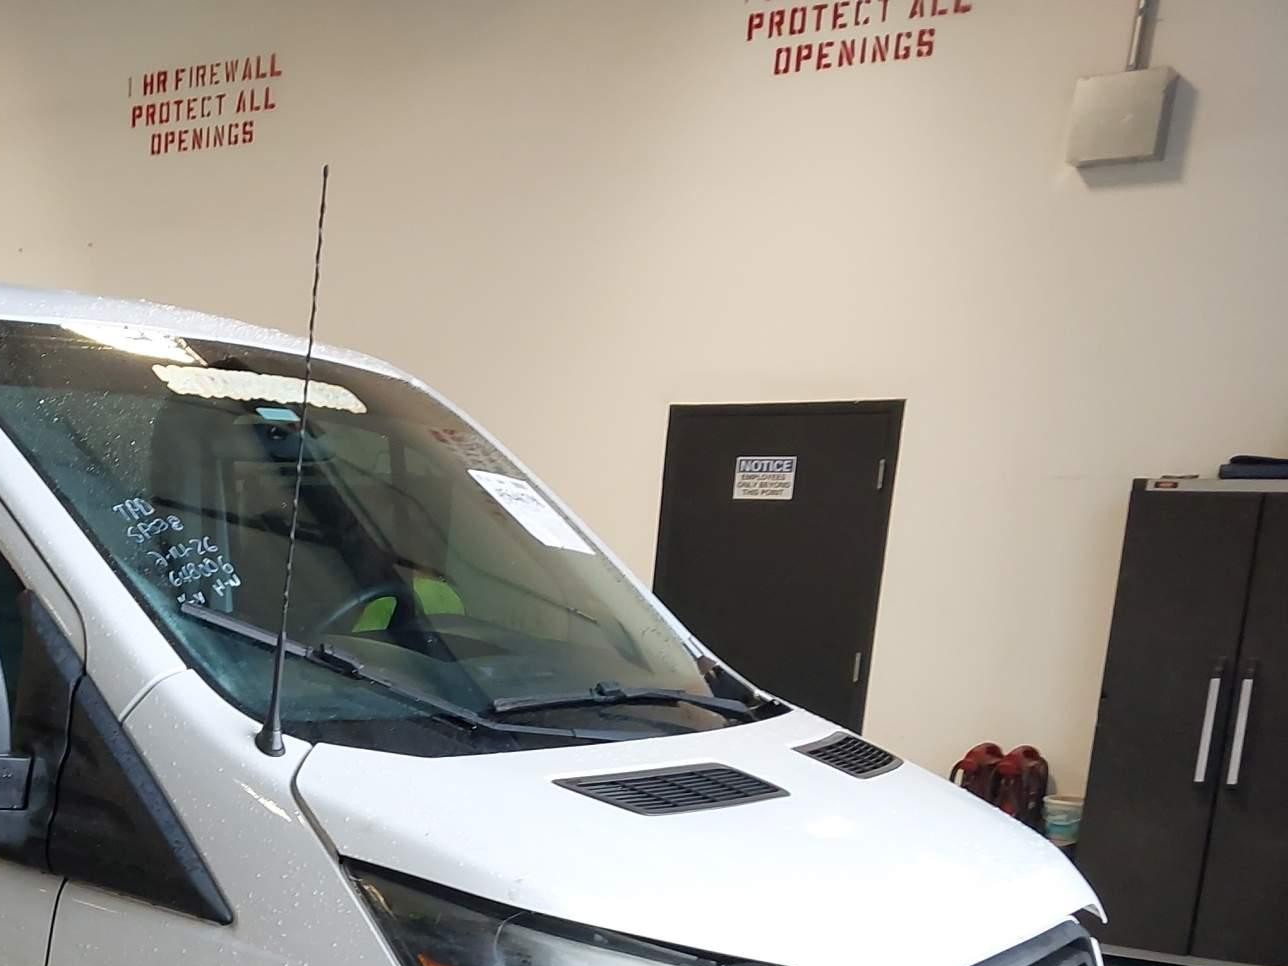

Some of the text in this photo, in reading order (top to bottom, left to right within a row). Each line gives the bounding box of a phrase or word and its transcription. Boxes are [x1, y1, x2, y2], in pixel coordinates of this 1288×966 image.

[746, 0, 889, 41] PROTECT
[773, 28, 936, 76] OPENINGS
[143, 70, 168, 96] HR
[175, 52, 282, 91] FIREWALL
[131, 87, 276, 128] PROTECT ALL
[150, 120, 254, 156] OPENINGS
[740, 460, 792, 472] NOTICE
